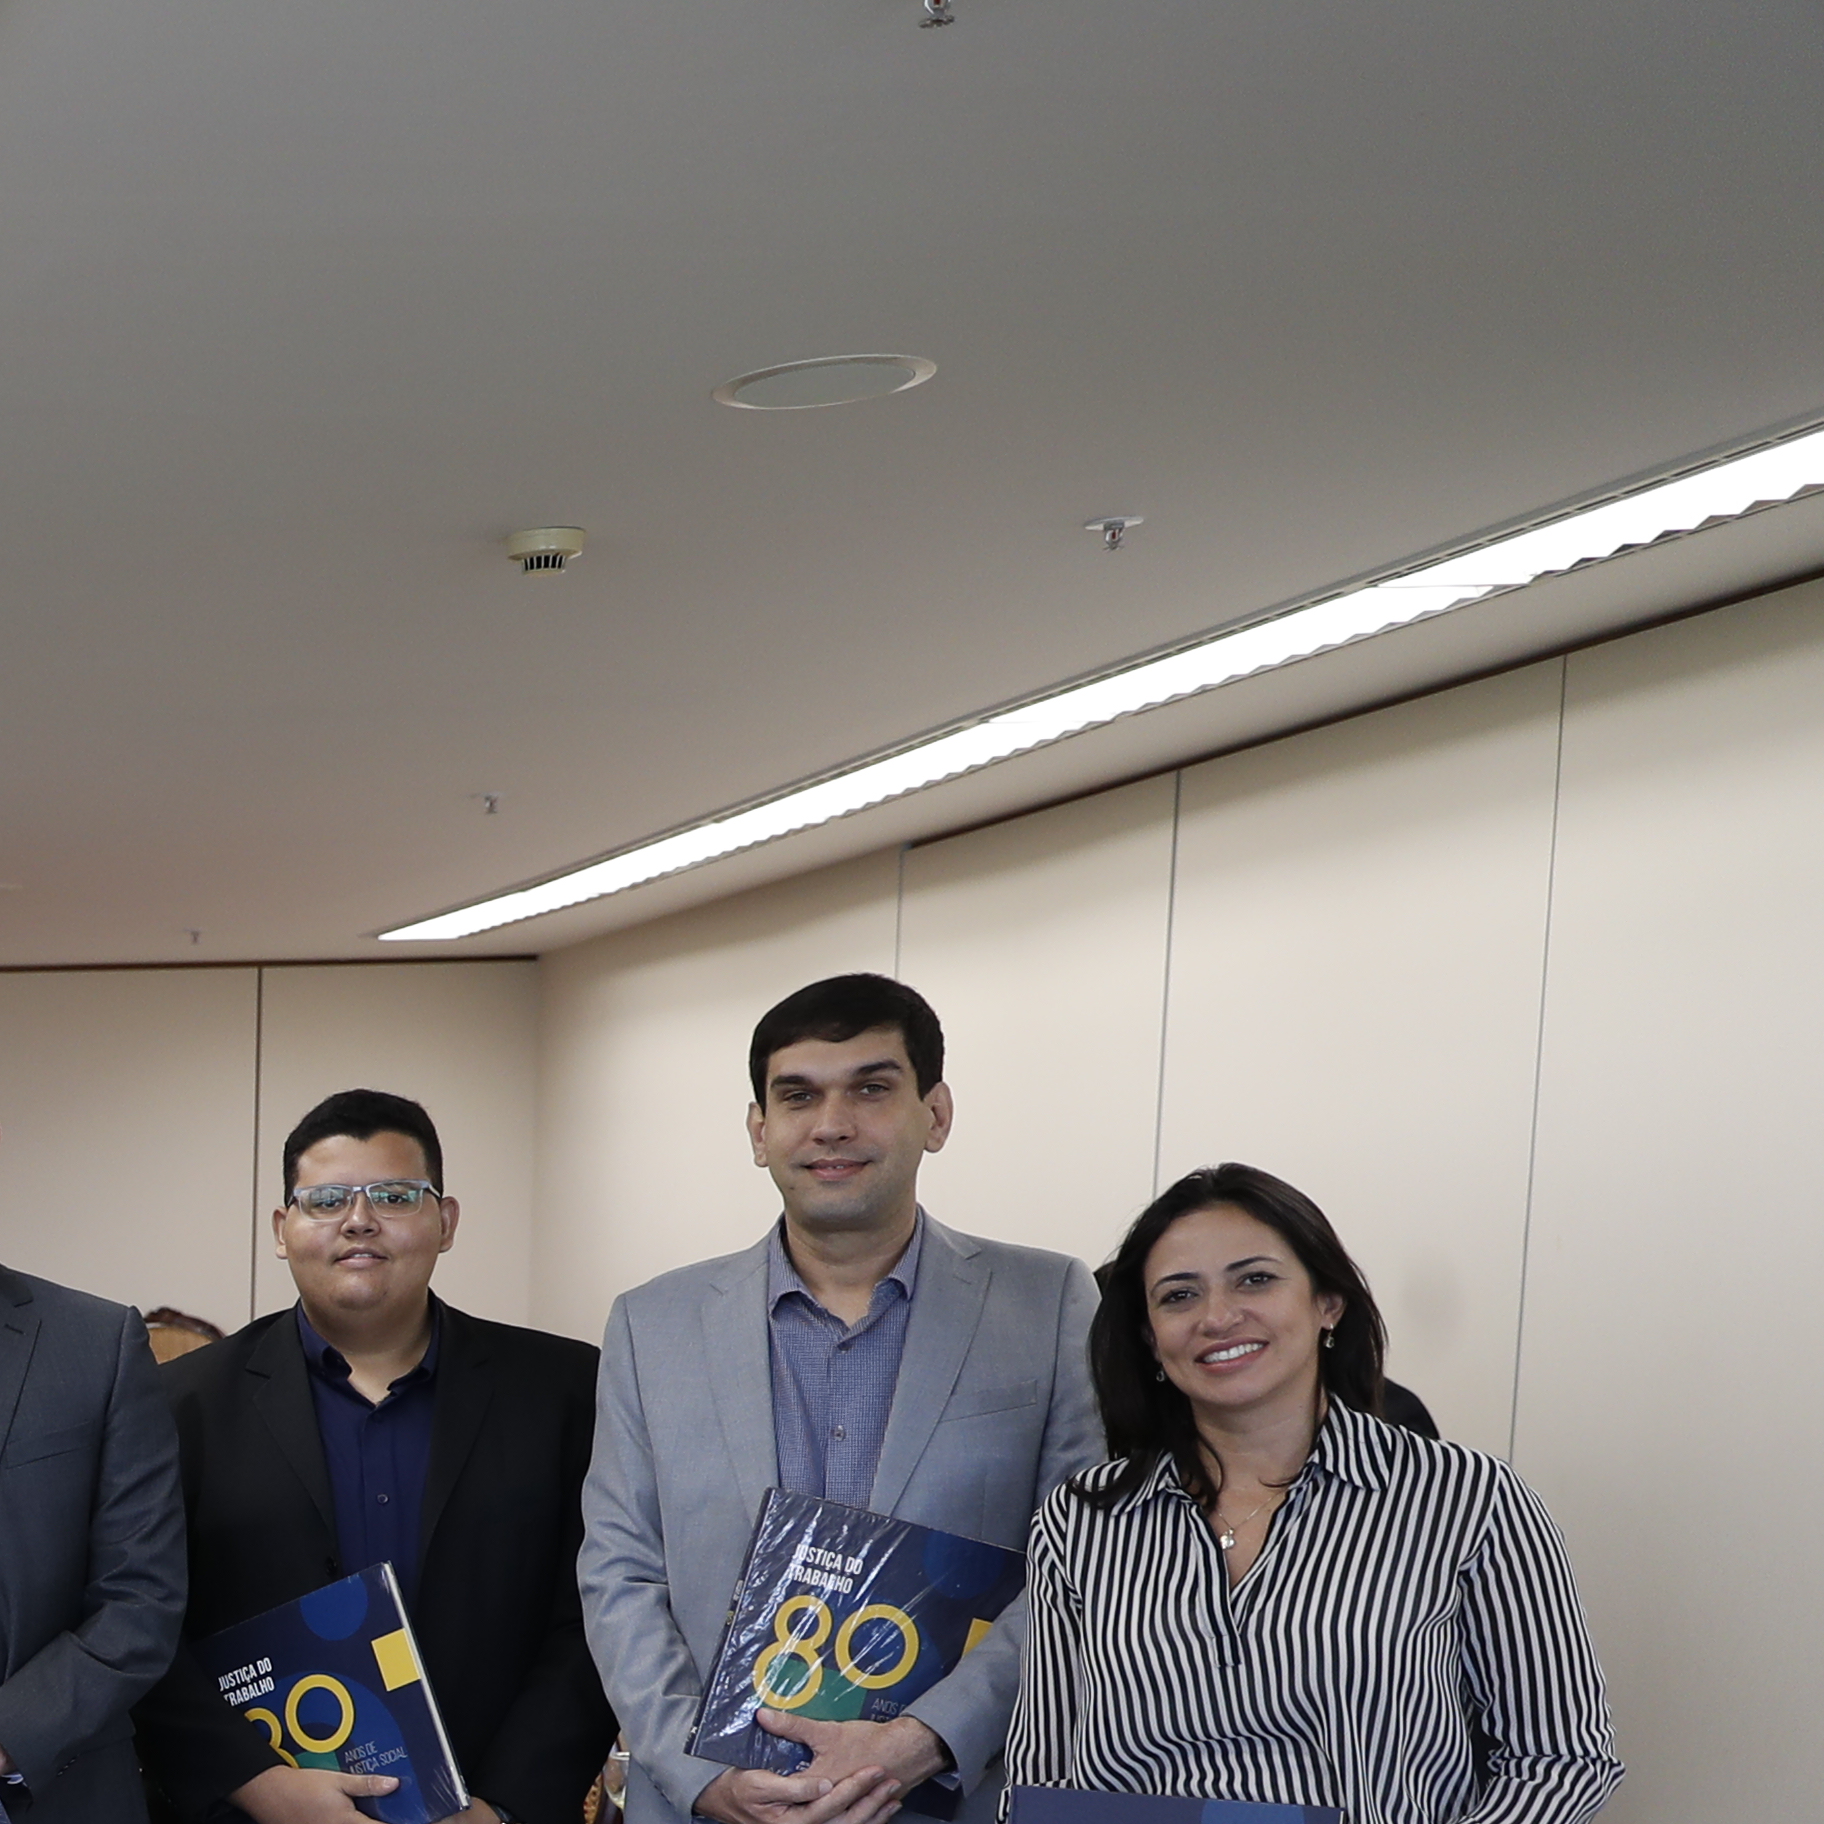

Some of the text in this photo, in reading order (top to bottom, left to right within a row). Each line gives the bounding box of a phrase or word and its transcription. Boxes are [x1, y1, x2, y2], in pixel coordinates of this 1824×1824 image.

[792, 1543, 863, 1575] JUSTIÇA DO
[753, 1595, 919, 1709] 80
[218, 1657, 272, 1692] JUSTIÇA DO
[871, 1698, 899, 1715] ANOS
[344, 1741, 378, 1764] ANOS DE
[379, 1746, 408, 1766] SOCIAL
